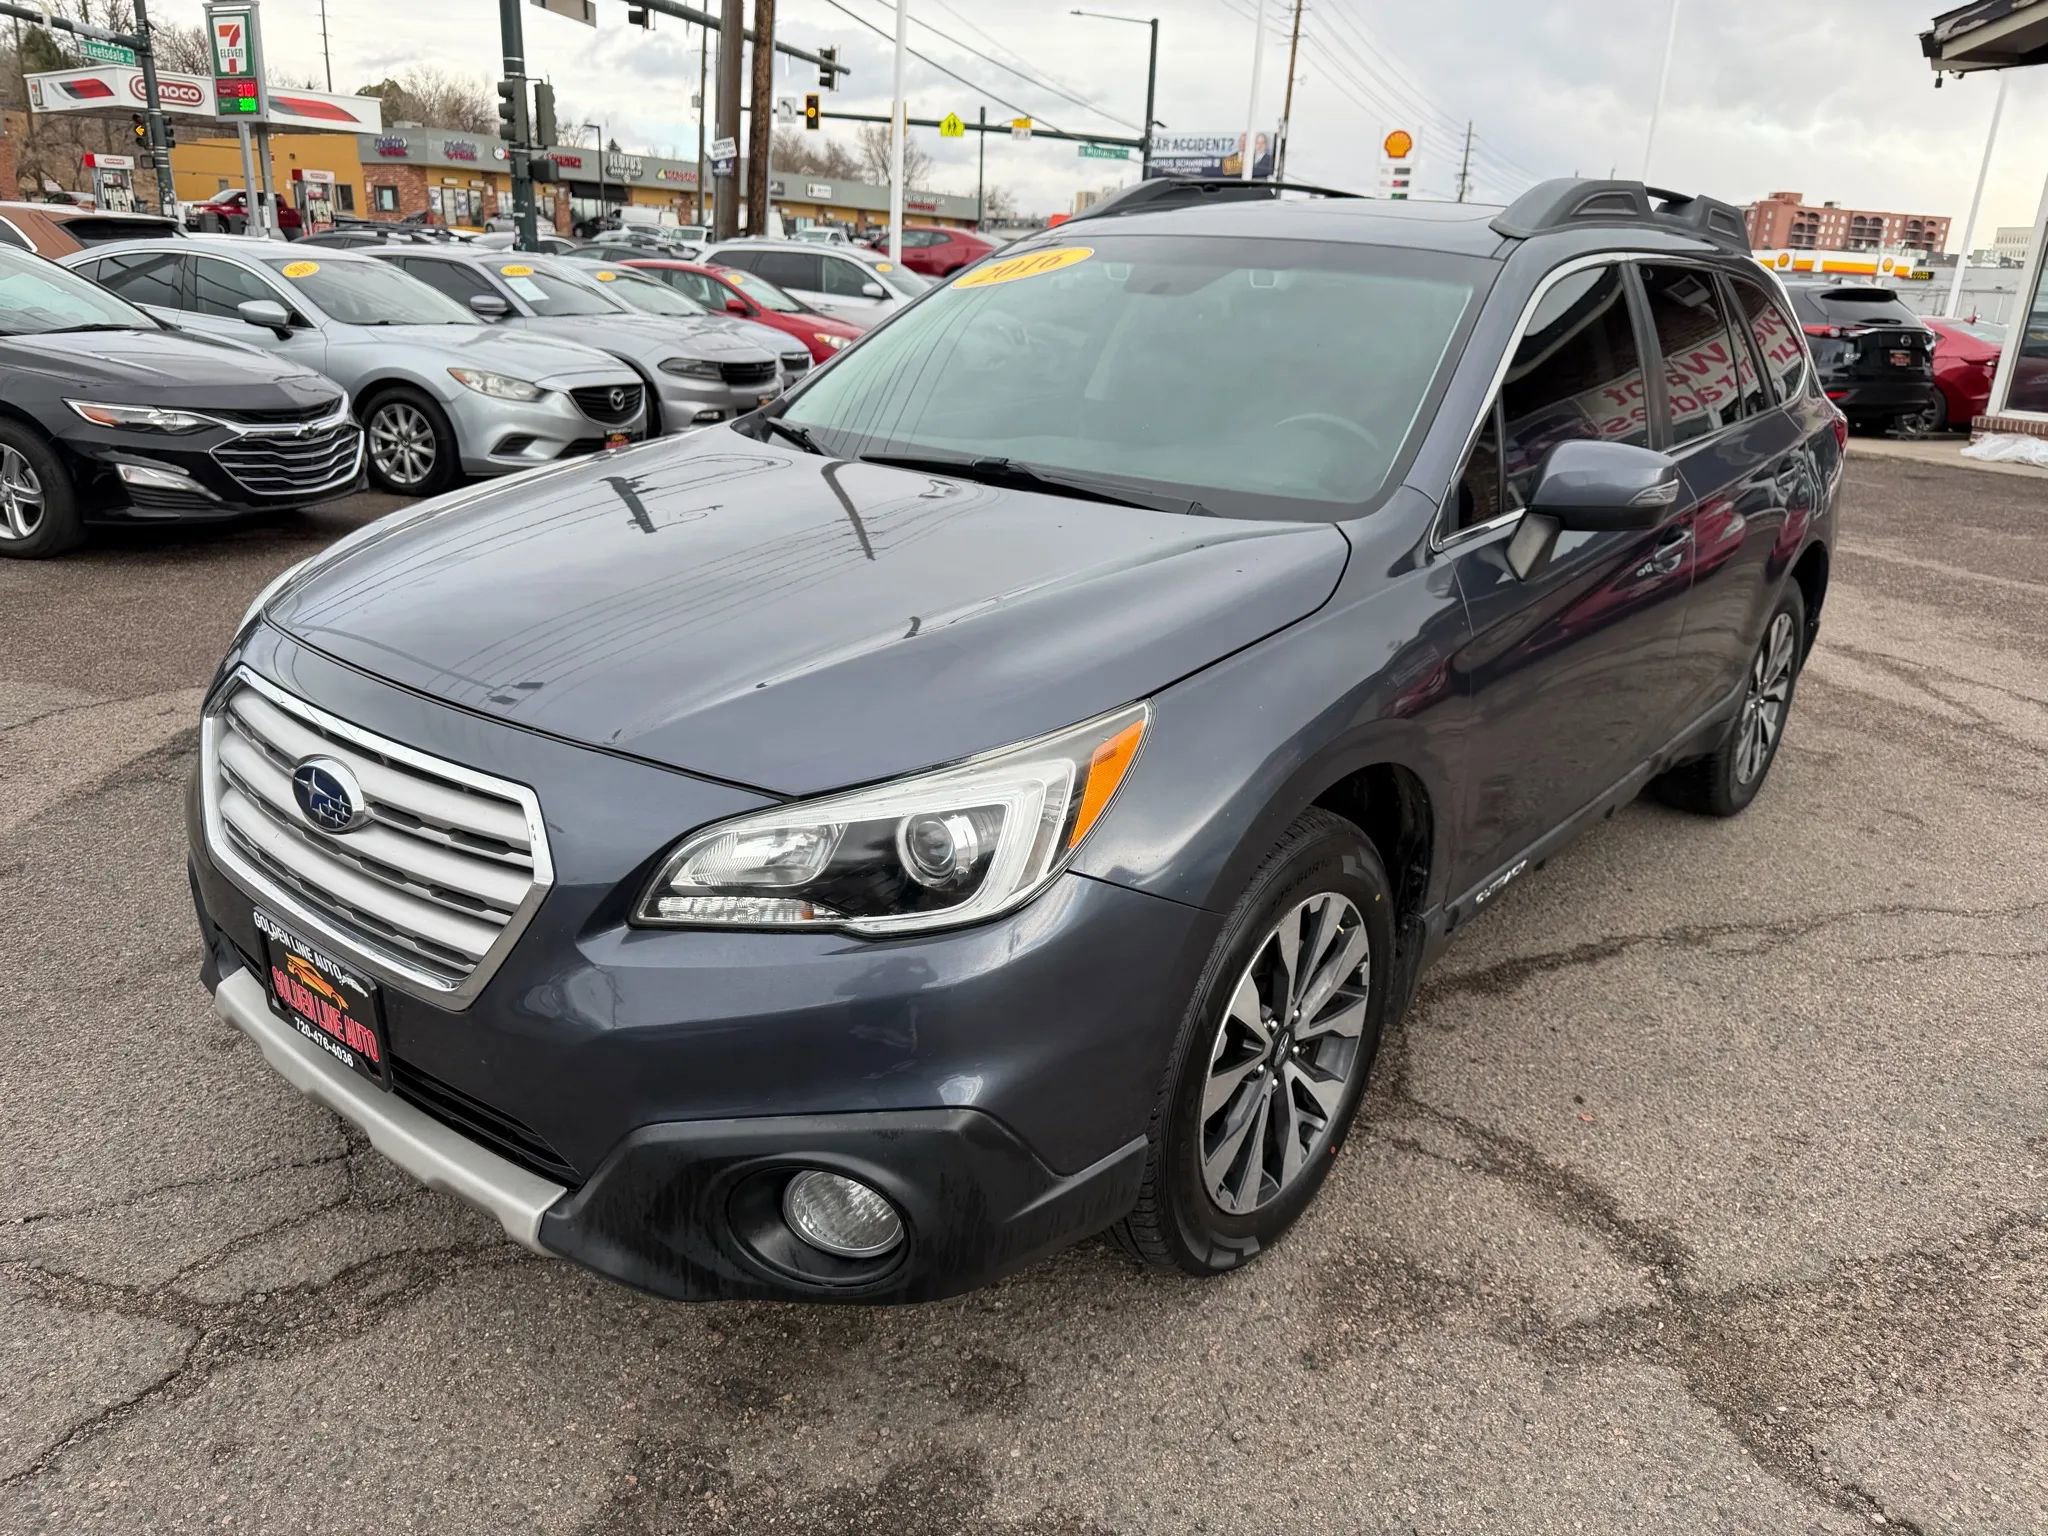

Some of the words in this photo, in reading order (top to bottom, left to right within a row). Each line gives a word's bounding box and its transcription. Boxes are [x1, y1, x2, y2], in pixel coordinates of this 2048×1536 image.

[88, 44, 125, 62] Leetsdale
[1172, 137, 1234, 152] ACCIDENT?
[968, 251, 1065, 285] 2016
[253, 911, 291, 949] GOLDEN
[289, 936, 314, 963] LINE
[313, 952, 342, 980] AUTO
[272, 966, 318, 1023] GOLDEN
[318, 1000, 345, 1042] LINE
[344, 1015, 379, 1063] AUTO
